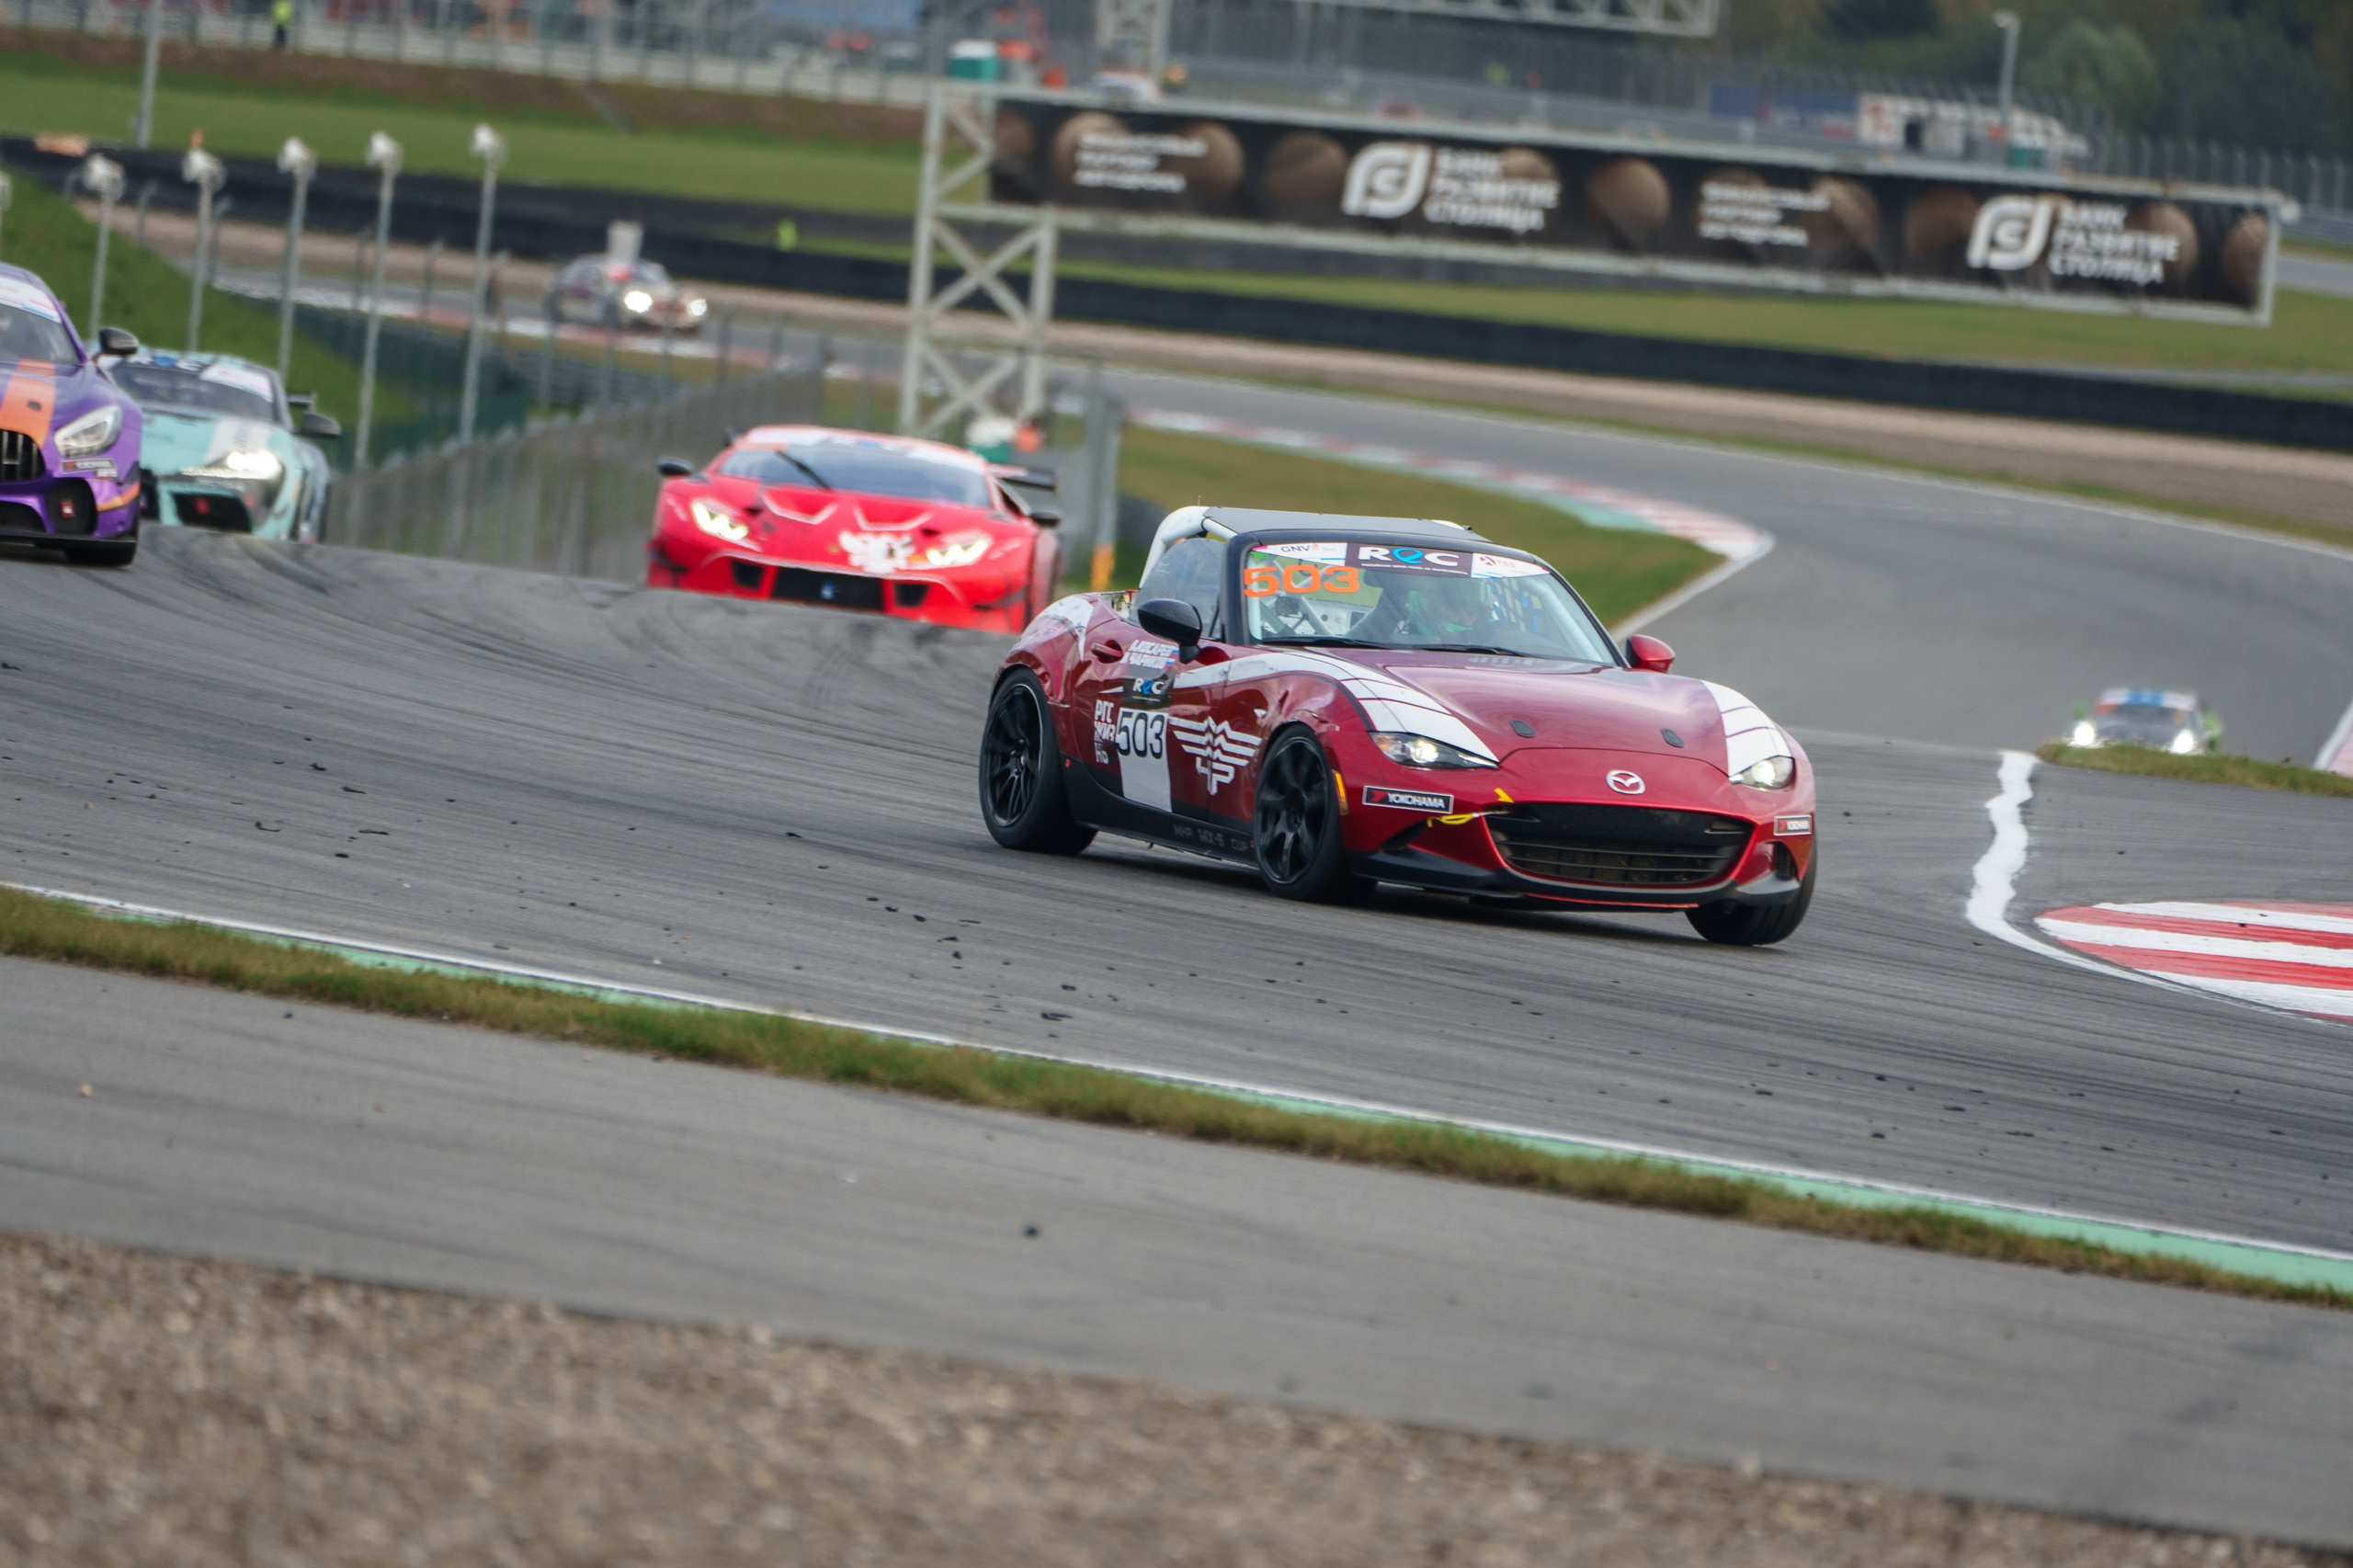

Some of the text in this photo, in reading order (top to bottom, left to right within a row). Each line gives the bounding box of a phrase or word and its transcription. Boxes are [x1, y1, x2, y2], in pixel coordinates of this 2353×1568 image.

[1244, 564, 1360, 597] 503
[1117, 711, 1165, 759] 503
[1387, 792, 1446, 809] YOKOHAMA
